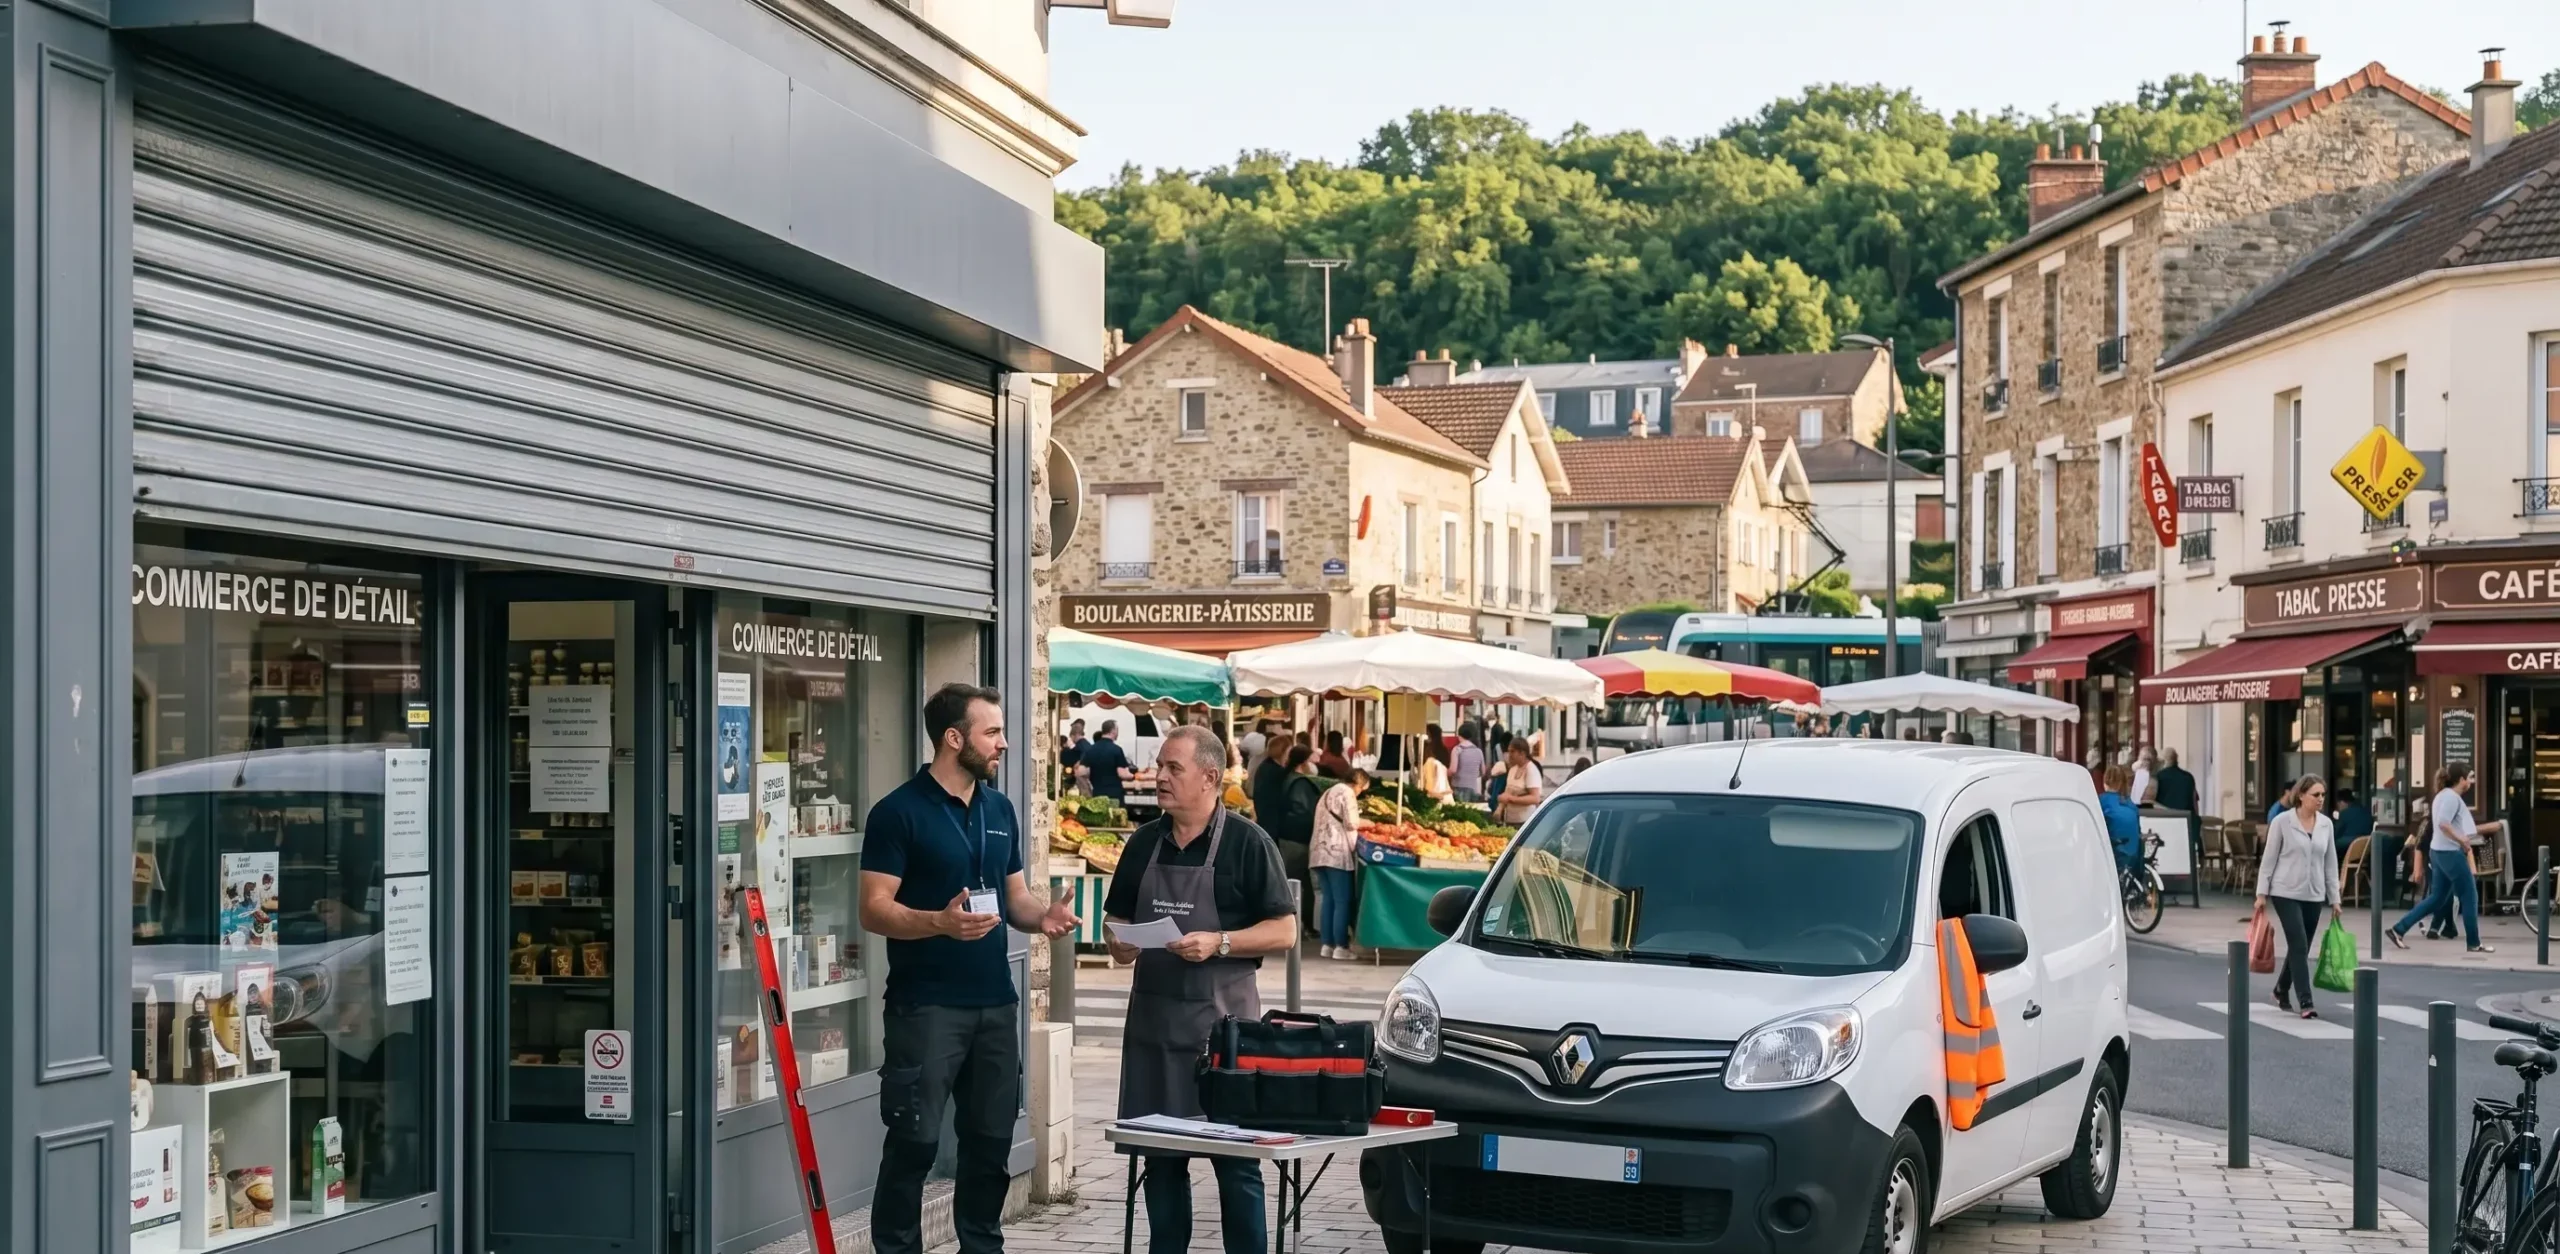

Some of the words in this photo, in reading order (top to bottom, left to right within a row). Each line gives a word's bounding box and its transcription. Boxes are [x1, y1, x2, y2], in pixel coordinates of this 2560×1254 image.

[2147, 456, 2173, 534] TABAC
[2184, 482, 2231, 495] TABAC
[132, 564, 286, 615] COMMERCE
[294, 579, 327, 618] DE
[334, 577, 415, 625] DÉTAIL
[1074, 599, 1314, 624] BOULANGERIE-PÂTISSERIE
[2276, 586, 2321, 618] TABAC
[2328, 578, 2386, 613] PRESSE
[732, 622, 814, 657] COMMERCE
[818, 630, 836, 659] DE
[839, 627, 882, 662] DÉTAIL
